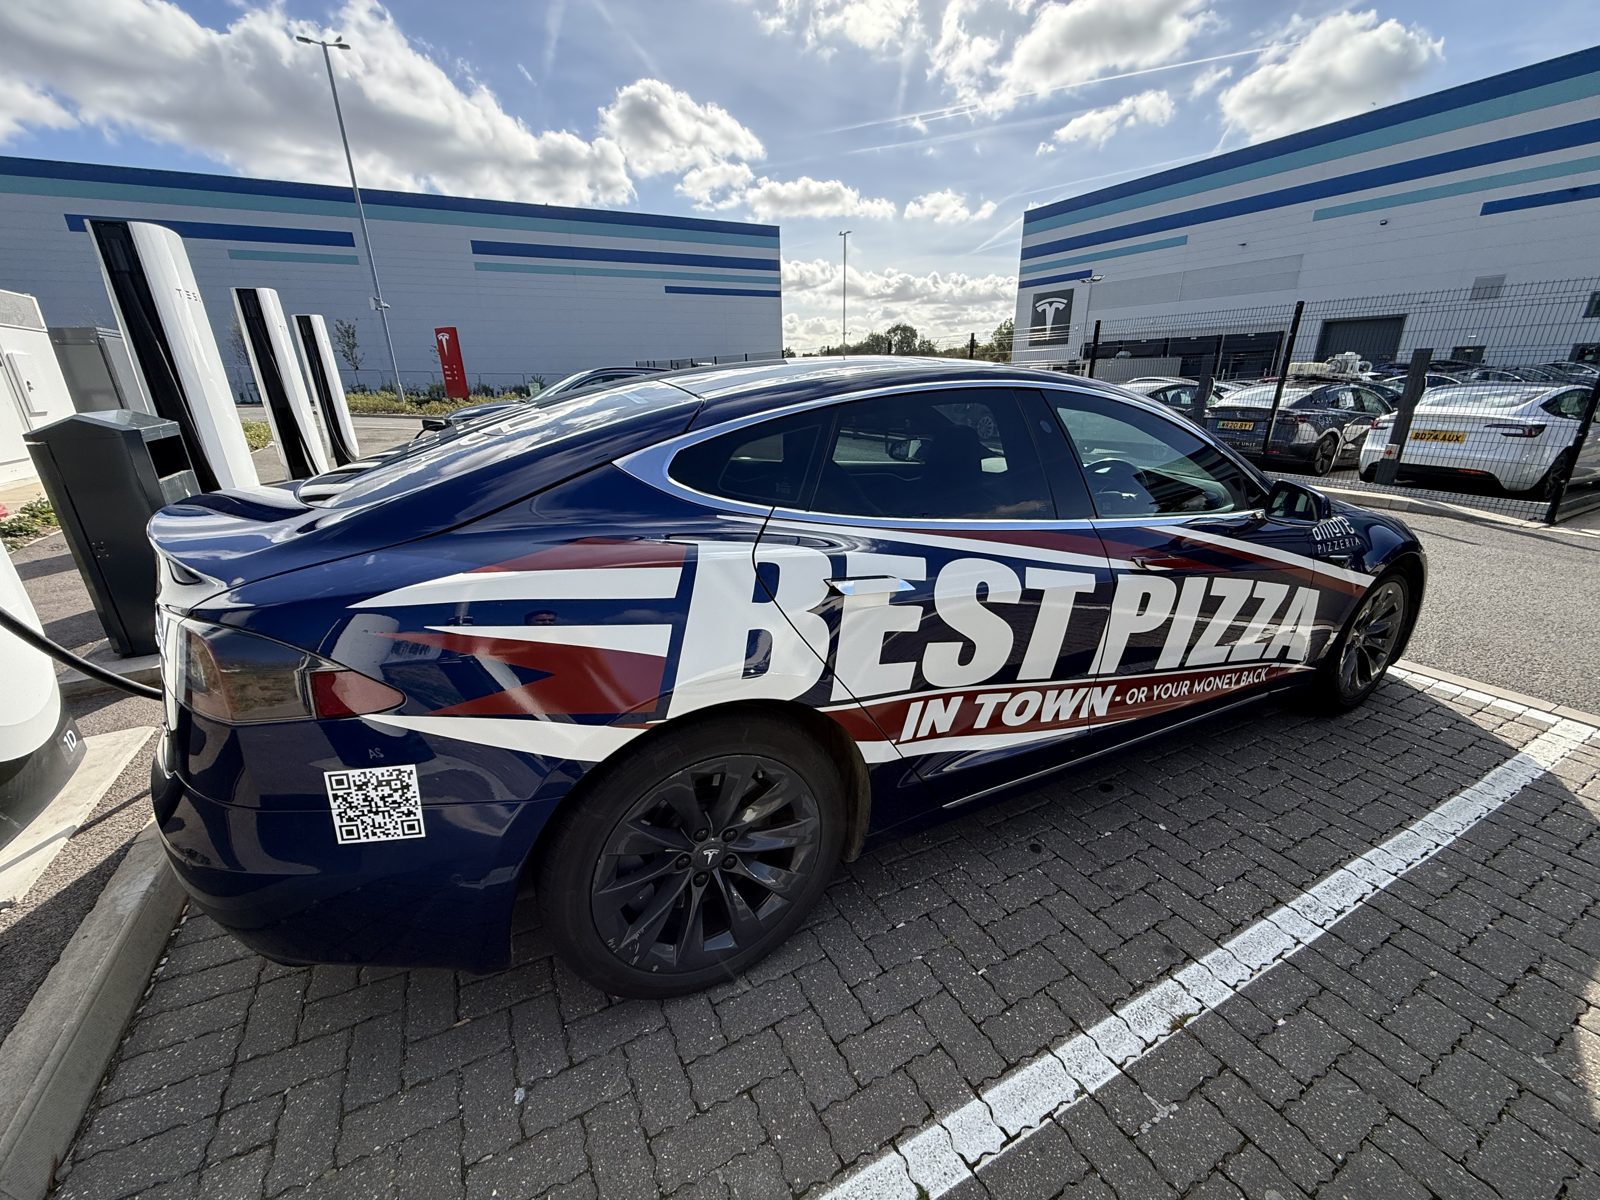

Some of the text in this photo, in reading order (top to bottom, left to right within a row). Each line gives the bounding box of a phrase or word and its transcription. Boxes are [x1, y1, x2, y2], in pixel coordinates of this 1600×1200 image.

[1413, 432, 1462, 442] BD74 AUX
[1317, 536, 1361, 554] PIZZERIA
[666, 539, 1321, 719] BEST PIZZA
[900, 695, 963, 742] IN
[974, 684, 1117, 730] TOWN
[1126, 687, 1147, 705] OR
[1152, 682, 1188, 701] YOUR
[1192, 674, 1239, 694] MONEY
[1240, 667, 1269, 686] BACK
[63, 729, 77, 752] 1D
